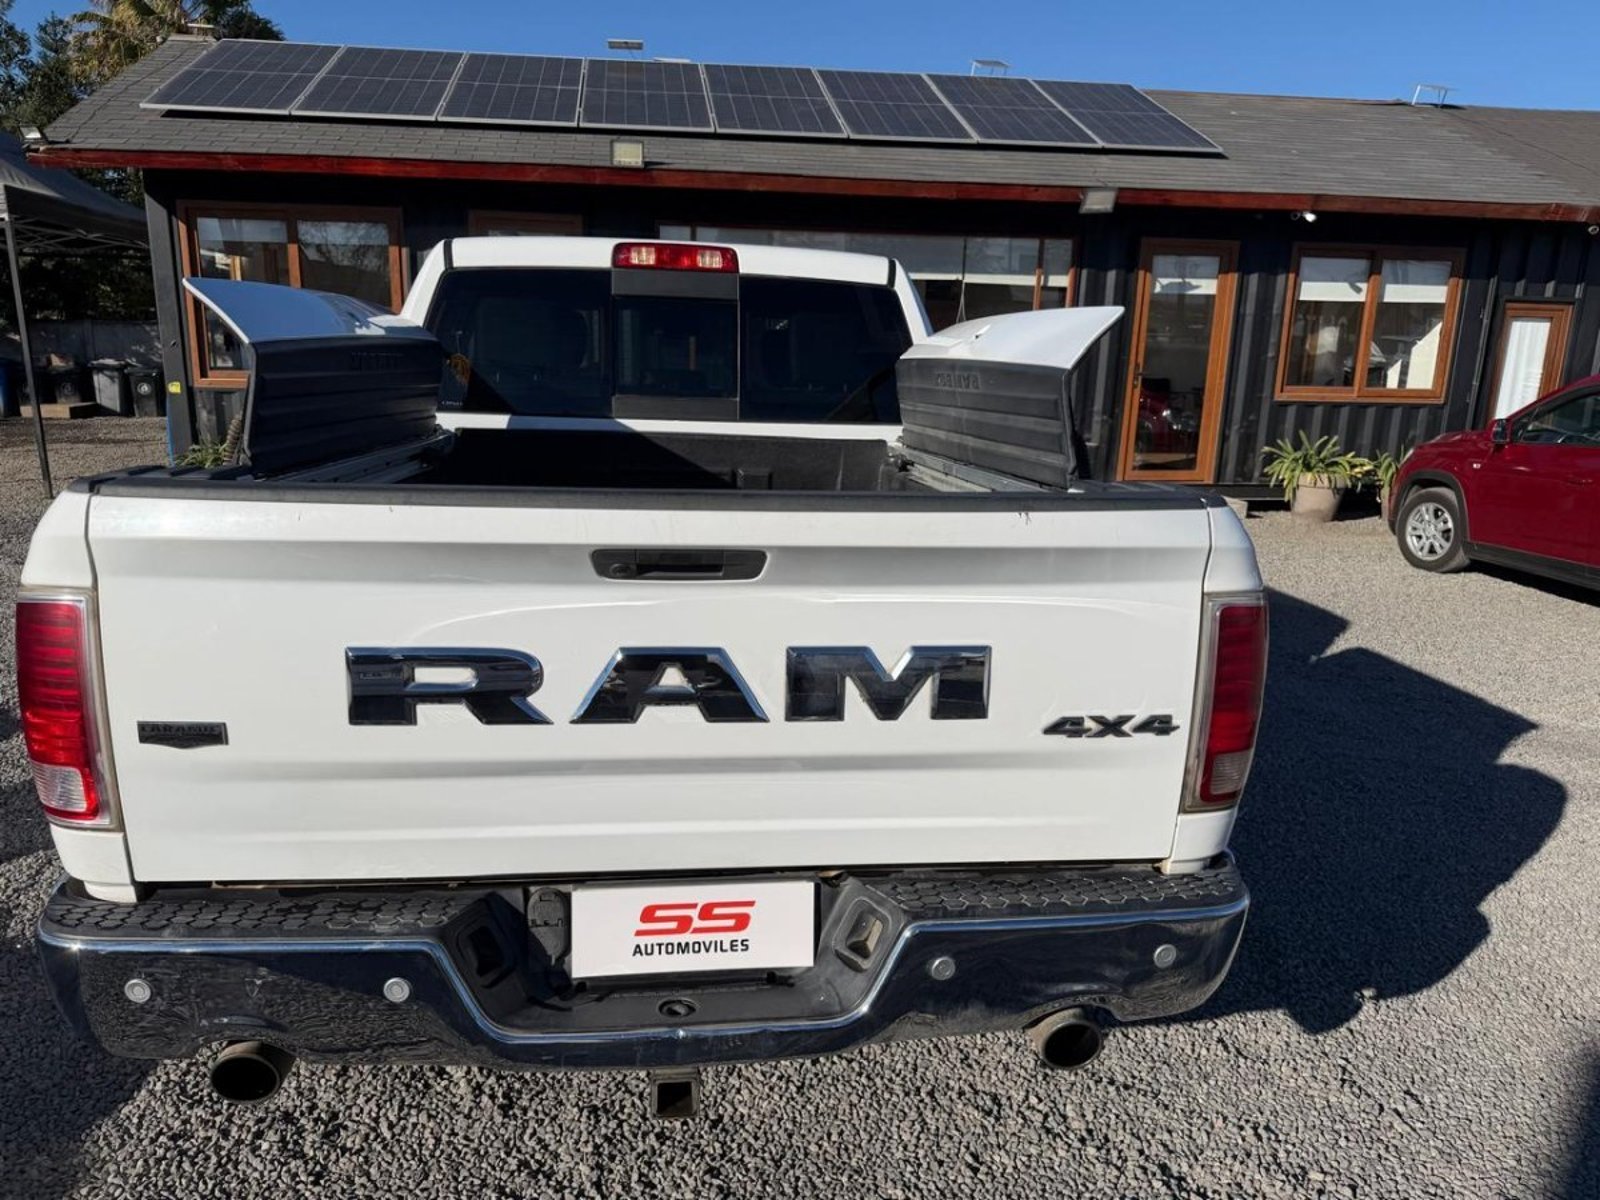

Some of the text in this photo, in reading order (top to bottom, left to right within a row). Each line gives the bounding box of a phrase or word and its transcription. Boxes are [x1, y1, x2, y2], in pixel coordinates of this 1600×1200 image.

[346, 645, 991, 725] RAM
[634, 900, 756, 937] SS
[632, 938, 750, 957] AUTOMOVILES
